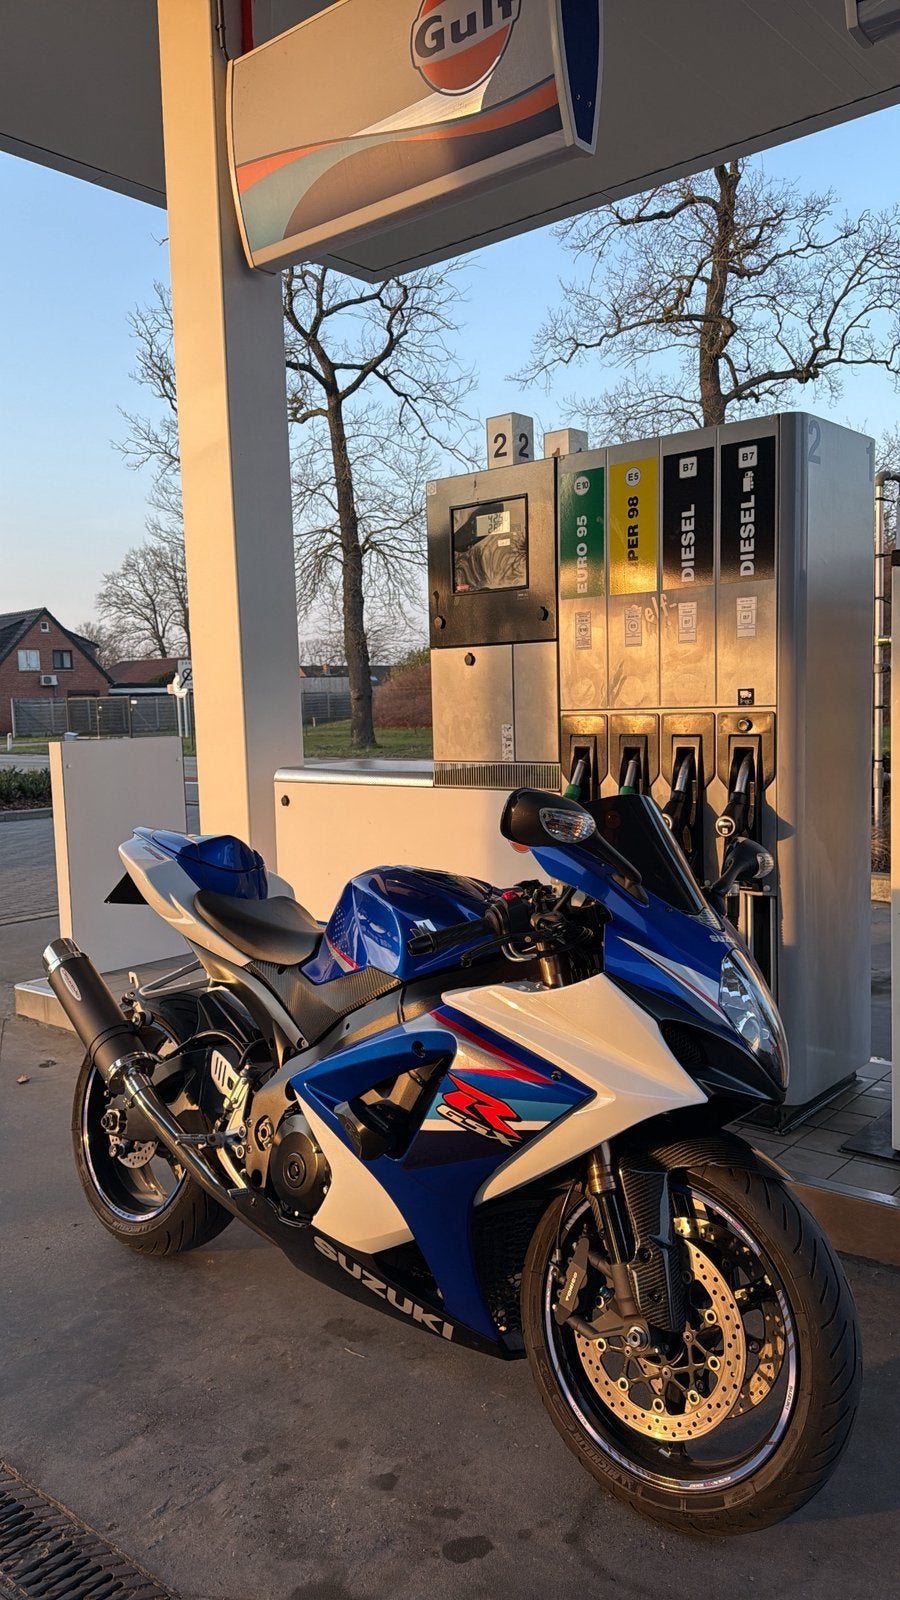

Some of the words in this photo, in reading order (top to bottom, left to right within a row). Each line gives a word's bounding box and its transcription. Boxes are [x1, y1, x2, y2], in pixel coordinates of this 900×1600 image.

[493, 432, 508, 459] 2
[518, 432, 530, 459] 2
[742, 451, 755, 461] B7
[808, 419, 821, 465] 2
[628, 472, 639, 481] E5
[682, 462, 695, 472] B7
[627, 495, 639, 519] 98
[576, 515, 588, 538] 95
[740, 494, 755, 577] DIESEL
[627, 524, 639, 568] PER
[681, 503, 695, 583] DIESEL
[576, 542, 588, 594] EURO
[436, 1103, 523, 1148] GSX
[313, 1235, 454, 1341] SUZUKI
[565, 1271, 578, 1302] TOKICO
